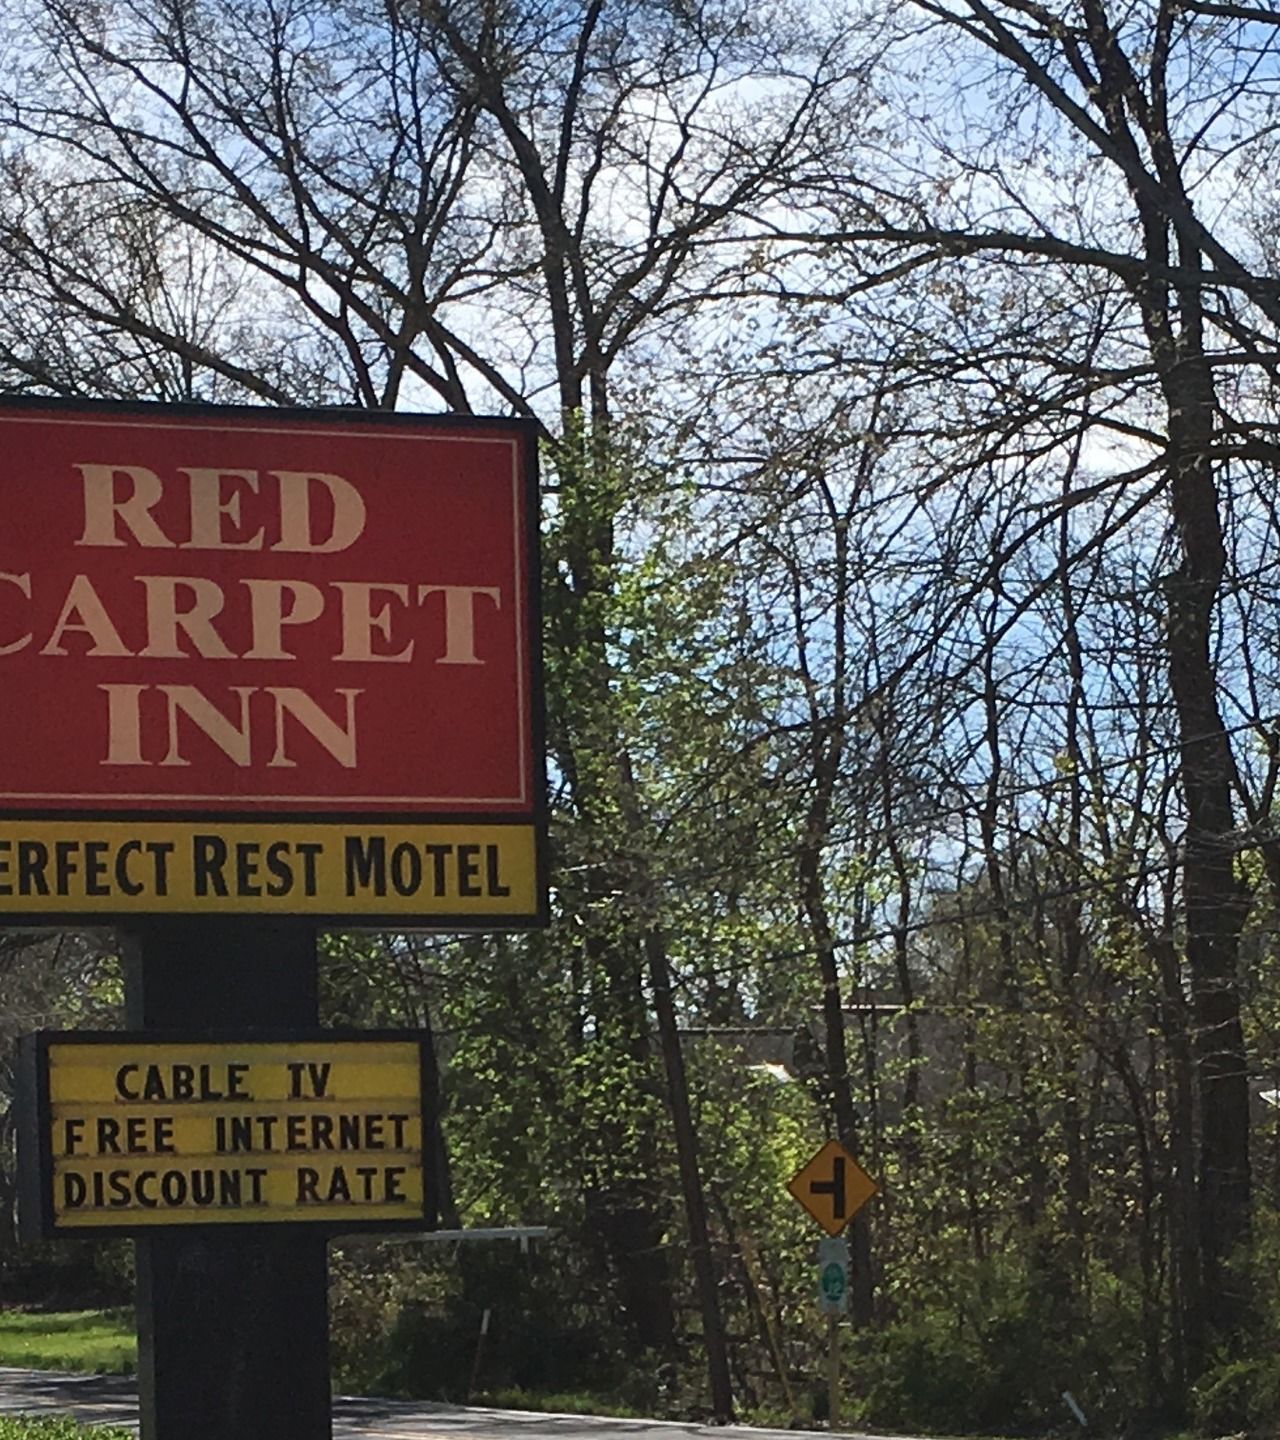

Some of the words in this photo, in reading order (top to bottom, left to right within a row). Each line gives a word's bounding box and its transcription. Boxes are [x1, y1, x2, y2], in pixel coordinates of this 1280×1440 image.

[71, 463, 368, 554] RED
[96, 683, 367, 769] INN
[193, 835, 324, 897] REST
[344, 836, 511, 897] MOTEL
[115, 1063, 250, 1099] CABLE
[287, 1062, 332, 1098] TV
[64, 1117, 175, 1155] FREE
[215, 1114, 410, 1152] INTERNET
[63, 1168, 268, 1208] DISCOUNT
[296, 1166, 407, 1204] RATE
